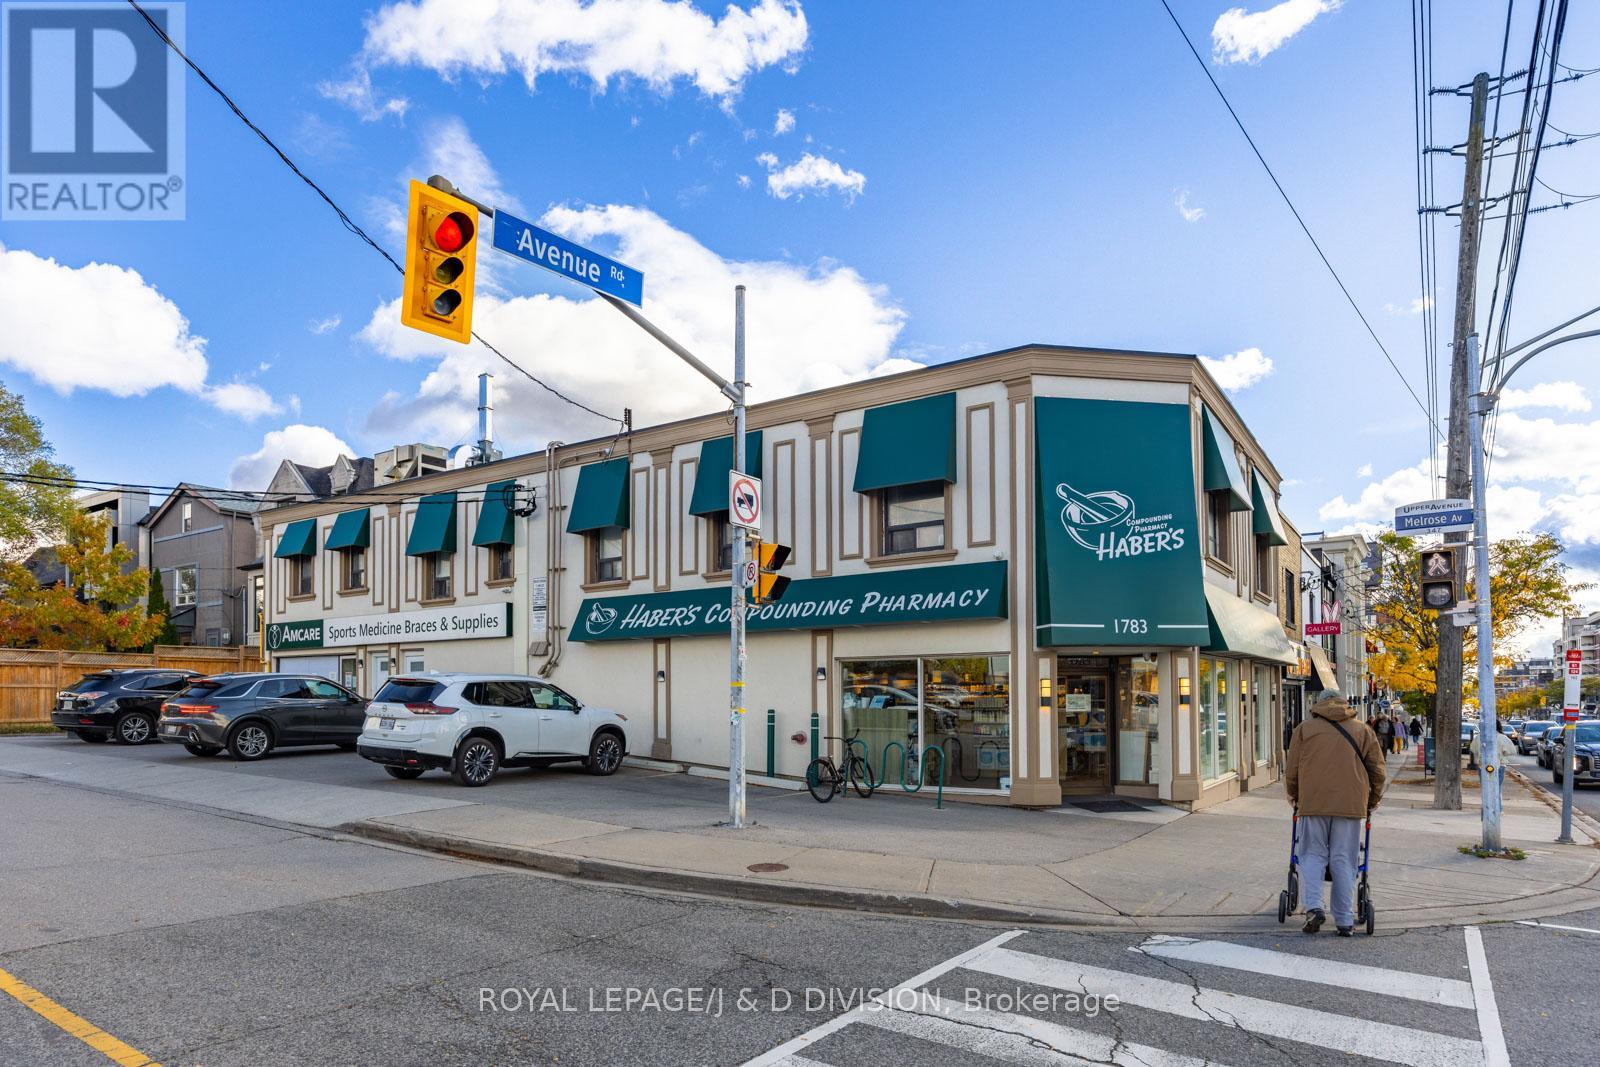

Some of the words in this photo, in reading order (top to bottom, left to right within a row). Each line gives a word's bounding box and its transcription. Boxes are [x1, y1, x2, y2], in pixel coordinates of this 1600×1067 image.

[518, 228, 601, 283] Avenue
[1126, 514, 1173, 526] COMPOUNDING
[1134, 523, 1168, 534] PHARMACY
[1405, 515, 1446, 527] Melrose
[1451, 514, 1463, 522] Av
[1096, 527, 1185, 561] HABER'S
[619, 603, 701, 630] HABER'S
[704, 598, 853, 625] COPOUNDING
[859, 588, 990, 614] PHARMACY
[282, 625, 321, 643] AMCARE
[328, 625, 357, 642] Sports
[360, 620, 402, 637] Medicine
[404, 617, 437, 634] Braces
[440, 616, 449, 632] &
[451, 614, 499, 634] Supplies
[1114, 619, 1148, 634] 1783
